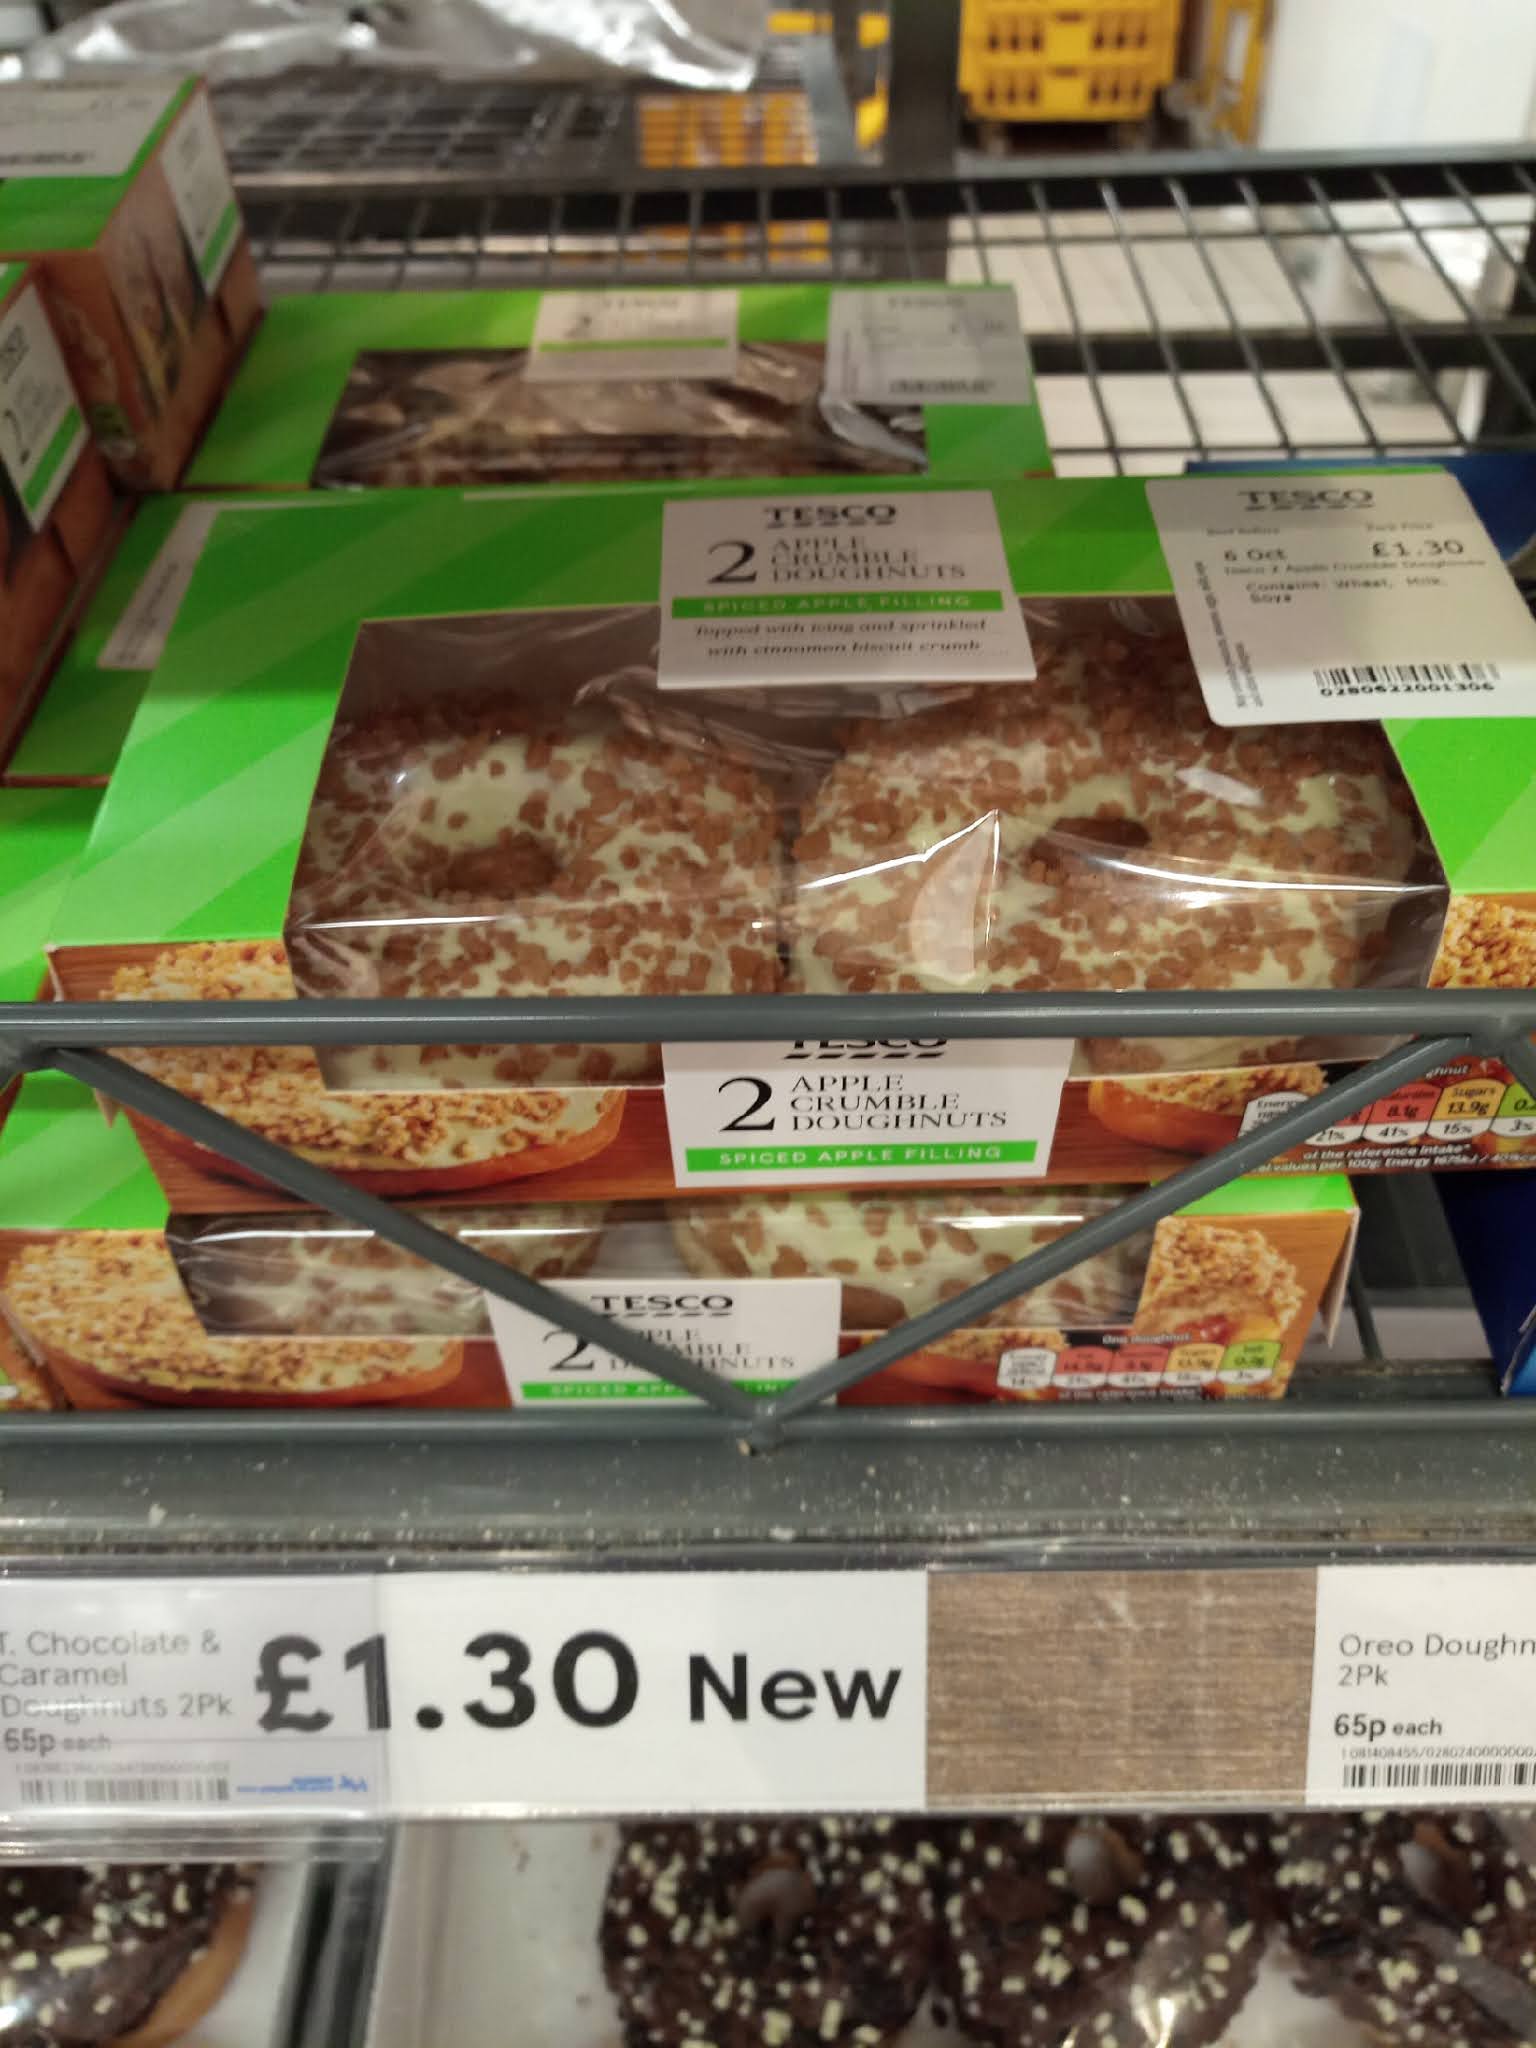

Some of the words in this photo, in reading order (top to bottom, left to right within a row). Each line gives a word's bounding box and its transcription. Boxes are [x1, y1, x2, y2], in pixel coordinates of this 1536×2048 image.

[1238, 489, 1375, 511] TESCO
[763, 504, 897, 528] TESCO
[774, 536, 866, 550] APPLE
[1371, 539, 1464, 558] £1.30
[707, 540, 757, 584] 2
[771, 549, 918, 566] CRUMBLE
[1247, 548, 1287, 561] Oct
[772, 564, 966, 582] DOUGHNUTS
[703, 598, 786, 613] SPICED
[798, 596, 867, 610] APPLE
[880, 594, 971, 608] FILLING
[766, 622, 805, 634] with
[859, 619, 896, 633] and
[901, 618, 987, 634] sprinkled
[708, 644, 748, 657] with
[753, 643, 847, 656] cinnamon
[852, 640, 914, 653] biscuit
[919, 639, 981, 652] crumb
[792, 1074, 903, 1092] APPLE
[718, 1076, 775, 1132] 2
[791, 1093, 960, 1112] CRUMBLE
[792, 1111, 1008, 1132] DOUGHNUTS
[719, 1150, 803, 1166] SPICED
[818, 1148, 894, 1164] APPLE
[904, 1146, 1003, 1162] FILLING
[1303, 1149, 1320, 1159] of
[1321, 1148, 1345, 1159] the
[1346, 1146, 1418, 1158] reference
[591, 1295, 733, 1318] TESCO
[543, 1330, 595, 1371] 2
[26, 1630, 190, 1657] Chocolate
[201, 1630, 221, 1655] &
[1339, 1633, 1414, 1657] Oreo
[1425, 1631, 1536, 1662] Doughn
[0, 1661, 128, 1688] Caramel
[255, 1630, 638, 1733] £1.30
[1338, 1663, 1389, 1687] 2Pk
[689, 1652, 902, 1723] New
[1, 1693, 169, 1724] Doughnuts
[178, 1693, 233, 1718] 2Pk
[1334, 1713, 1386, 1742] 65p
[1392, 1717, 1443, 1736] each
[4, 1727, 56, 1757] 65p
[62, 1732, 112, 1752] each
